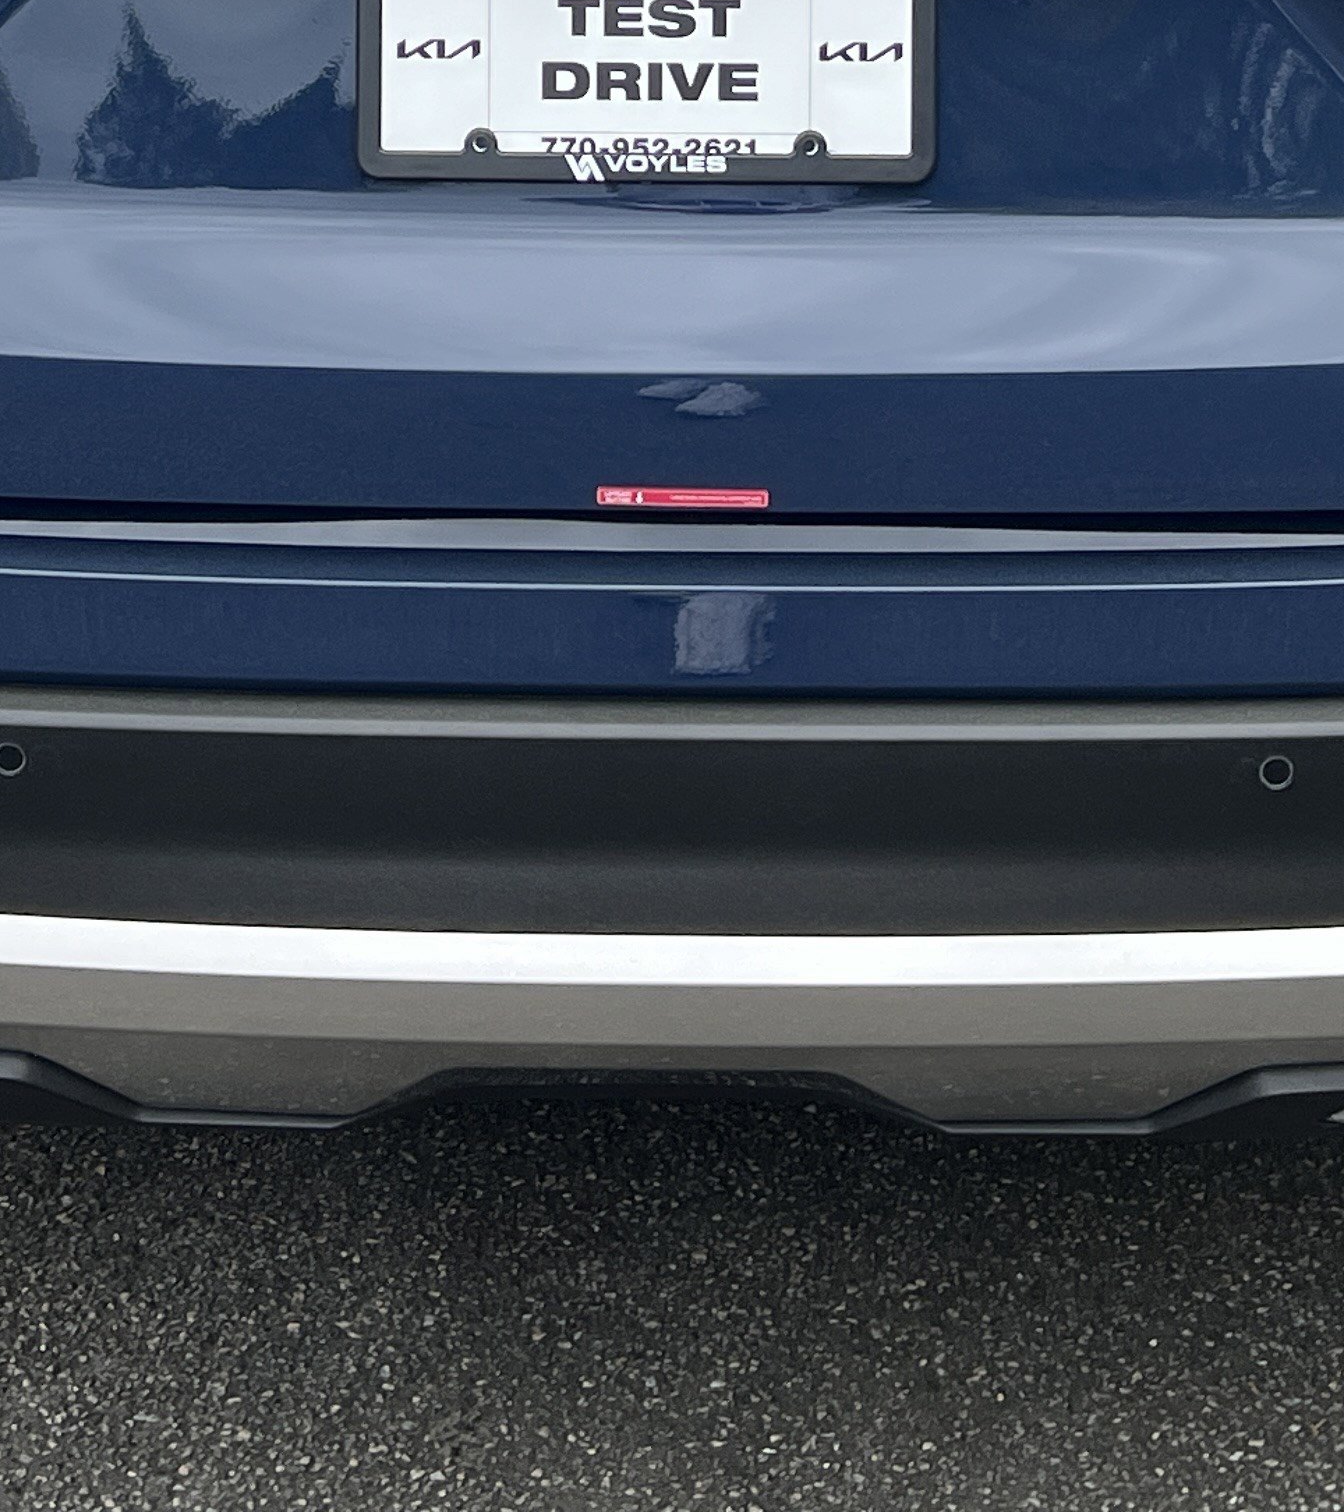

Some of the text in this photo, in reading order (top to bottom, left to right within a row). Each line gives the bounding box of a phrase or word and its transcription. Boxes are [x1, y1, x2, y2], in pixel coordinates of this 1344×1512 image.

[541, 61, 759, 102] DRIVE
[541, 137, 757, 156] 770-952-2621
[604, 155, 727, 173] VOYLES
